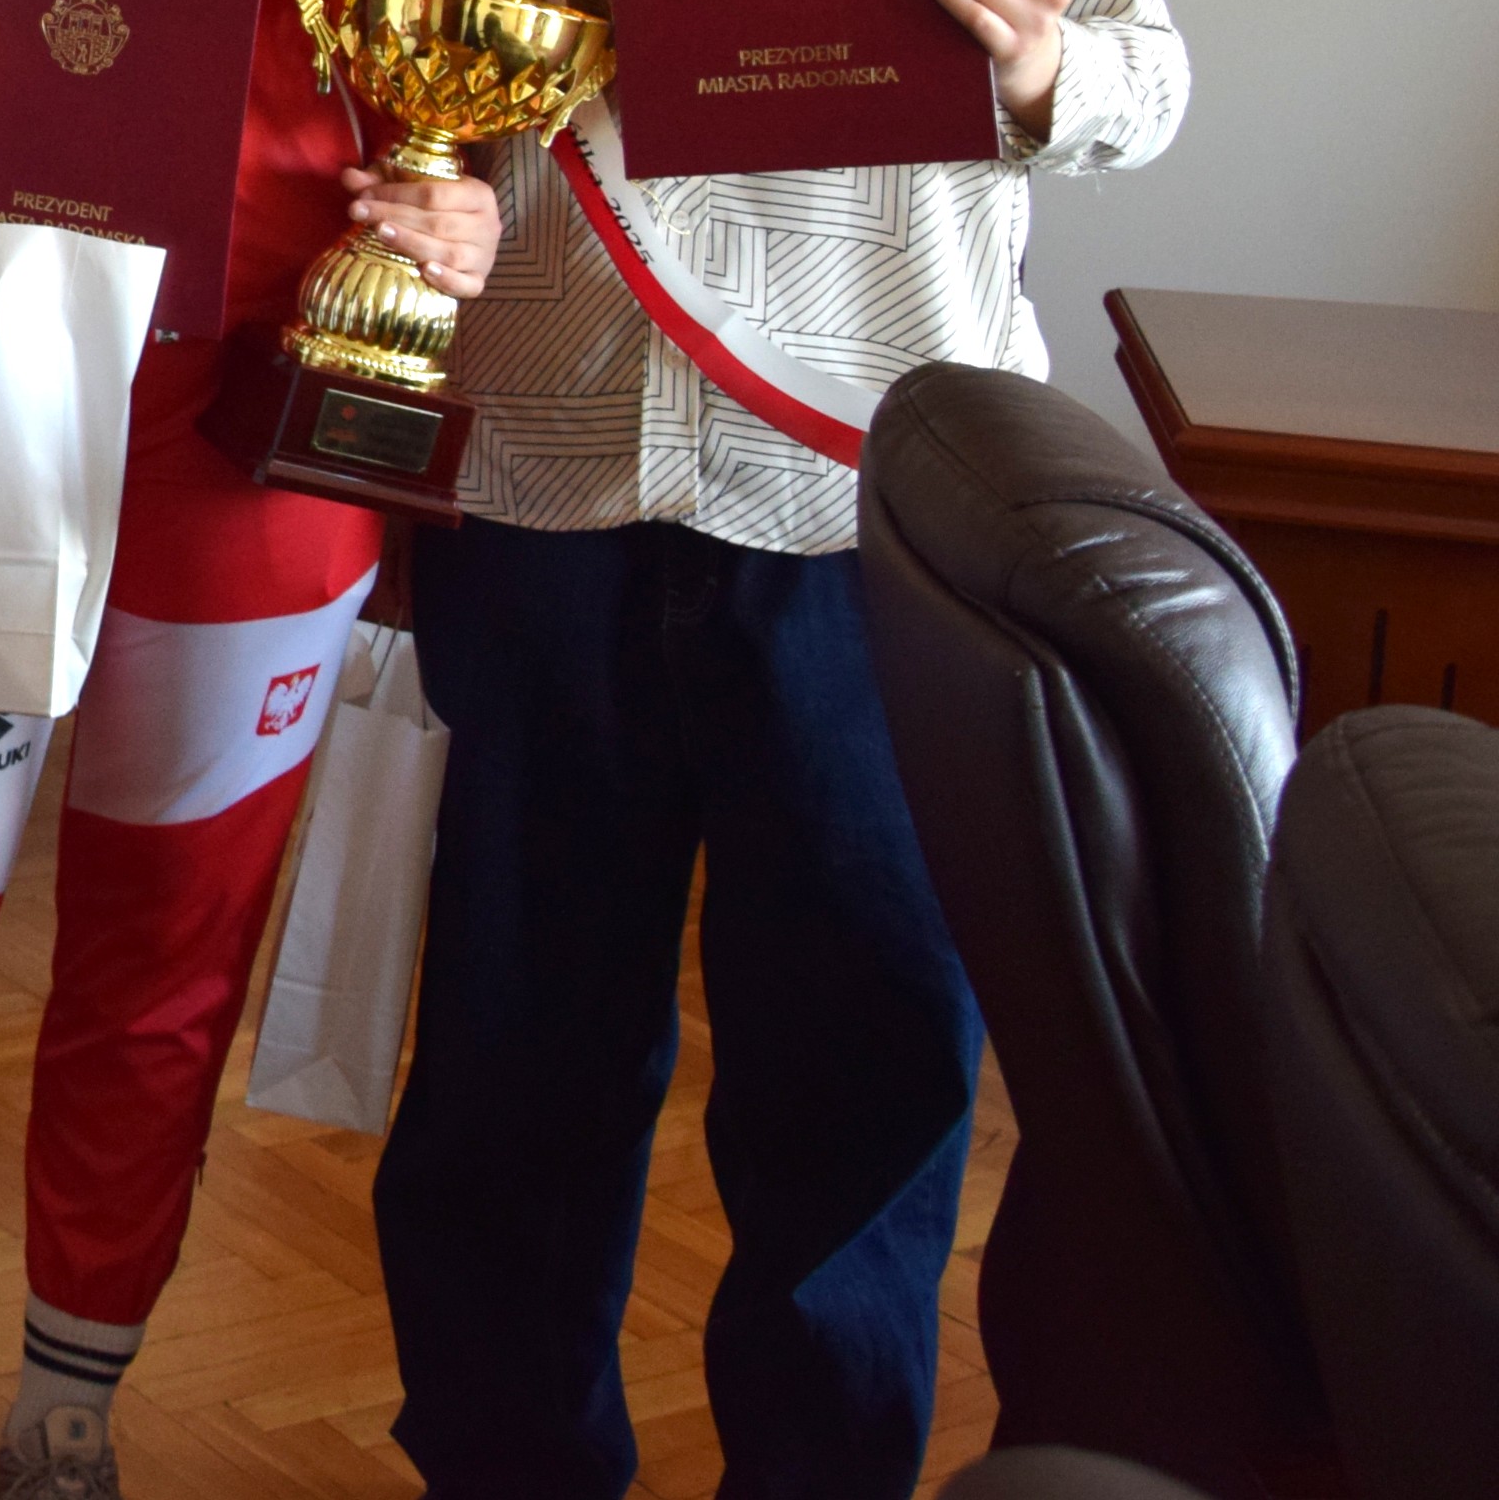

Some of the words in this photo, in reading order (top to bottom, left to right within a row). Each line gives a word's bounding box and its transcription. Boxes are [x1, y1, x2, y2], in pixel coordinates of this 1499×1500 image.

[739, 43, 852, 67] PREZYDENT
[698, 74, 773, 95] MIASTA
[778, 66, 900, 90] RADOMSKA
[13, 191, 113, 223] PREZYDENT
[604, 197, 654, 265] 2025
